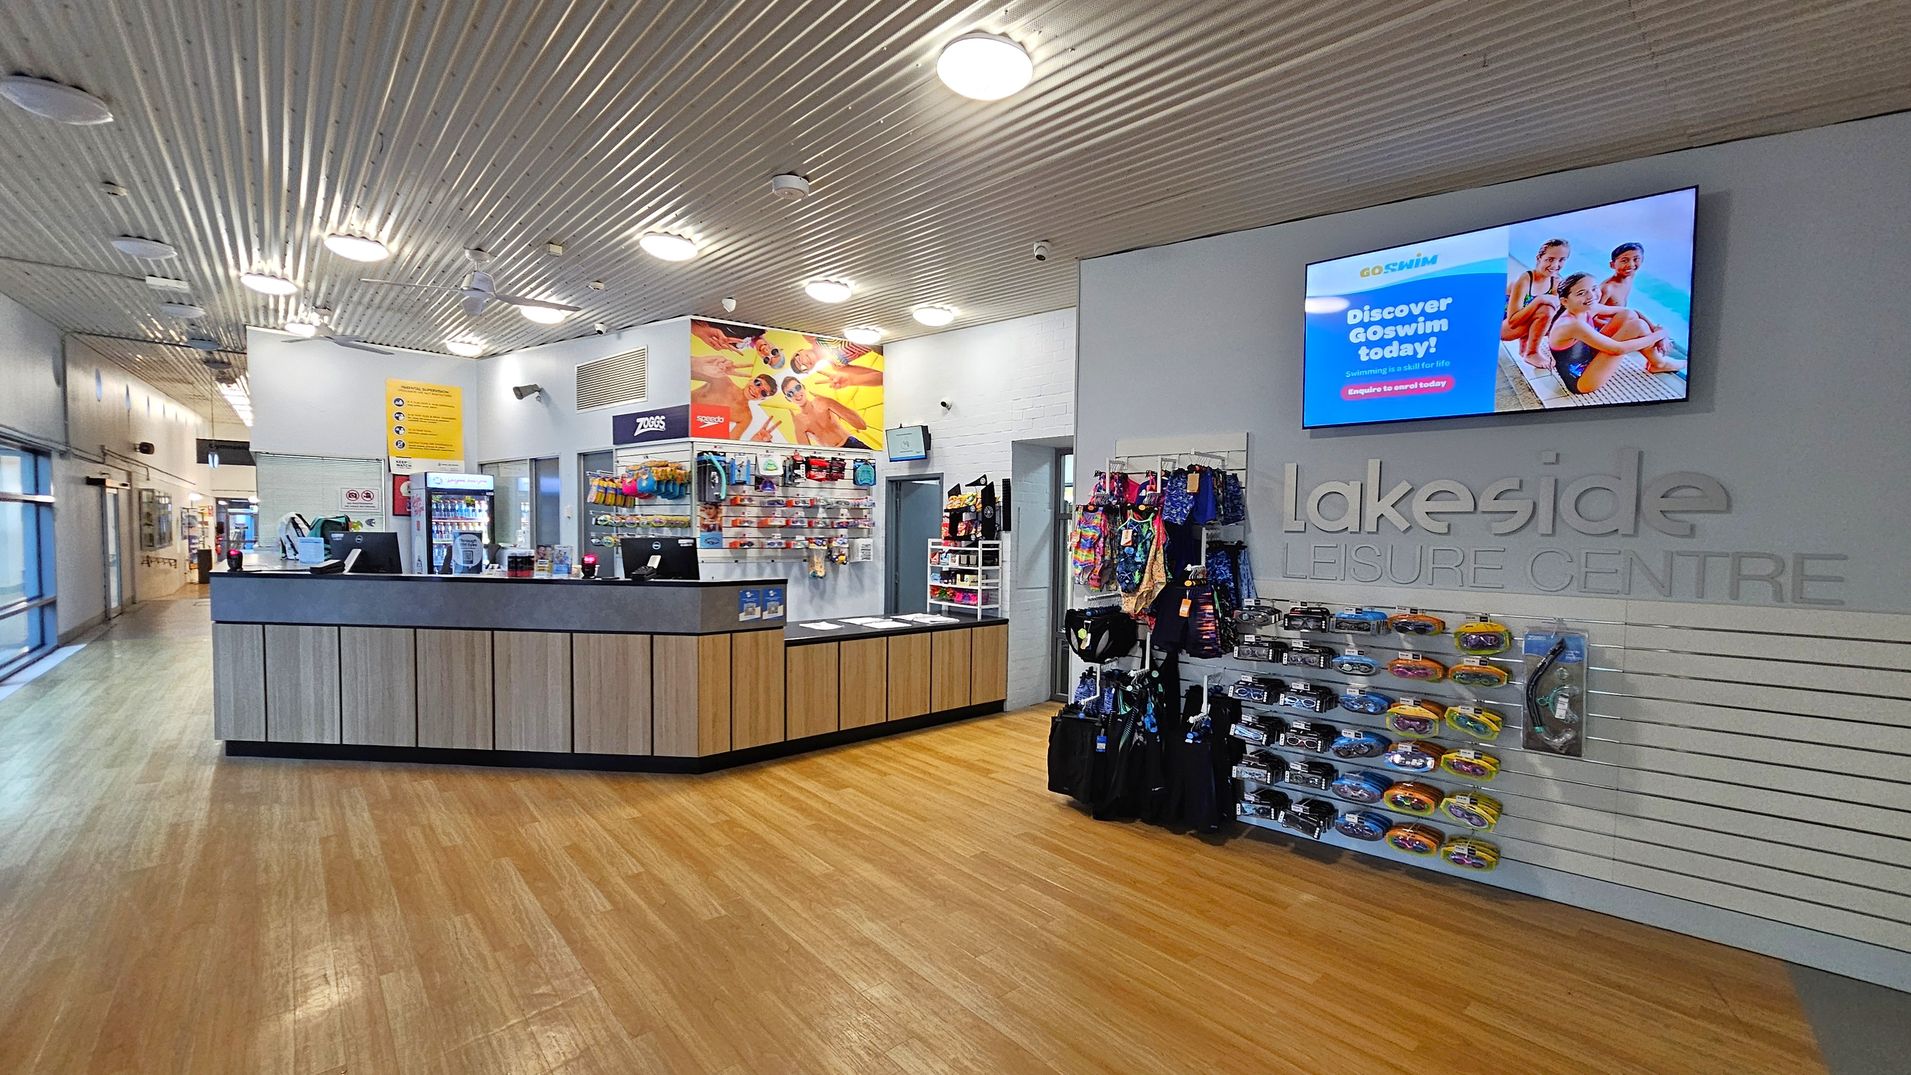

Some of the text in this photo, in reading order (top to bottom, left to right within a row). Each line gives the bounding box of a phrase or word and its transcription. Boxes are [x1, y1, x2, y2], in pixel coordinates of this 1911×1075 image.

[1346, 296, 1453, 325] Discover
[1349, 316, 1449, 344] GOswim
[1358, 336, 1437, 362] today!
[1345, 367, 1387, 378] Swimming
[1402, 362, 1420, 372] skill
[1421, 361, 1435, 370] for
[1435, 359, 1450, 368] life
[1347, 385, 1382, 396] Enquire
[1419, 380, 1447, 390] today
[634, 415, 666, 437] ZOGGS
[696, 415, 724, 424] speedo
[1283, 542, 1848, 606] LEISURE CENTRE
